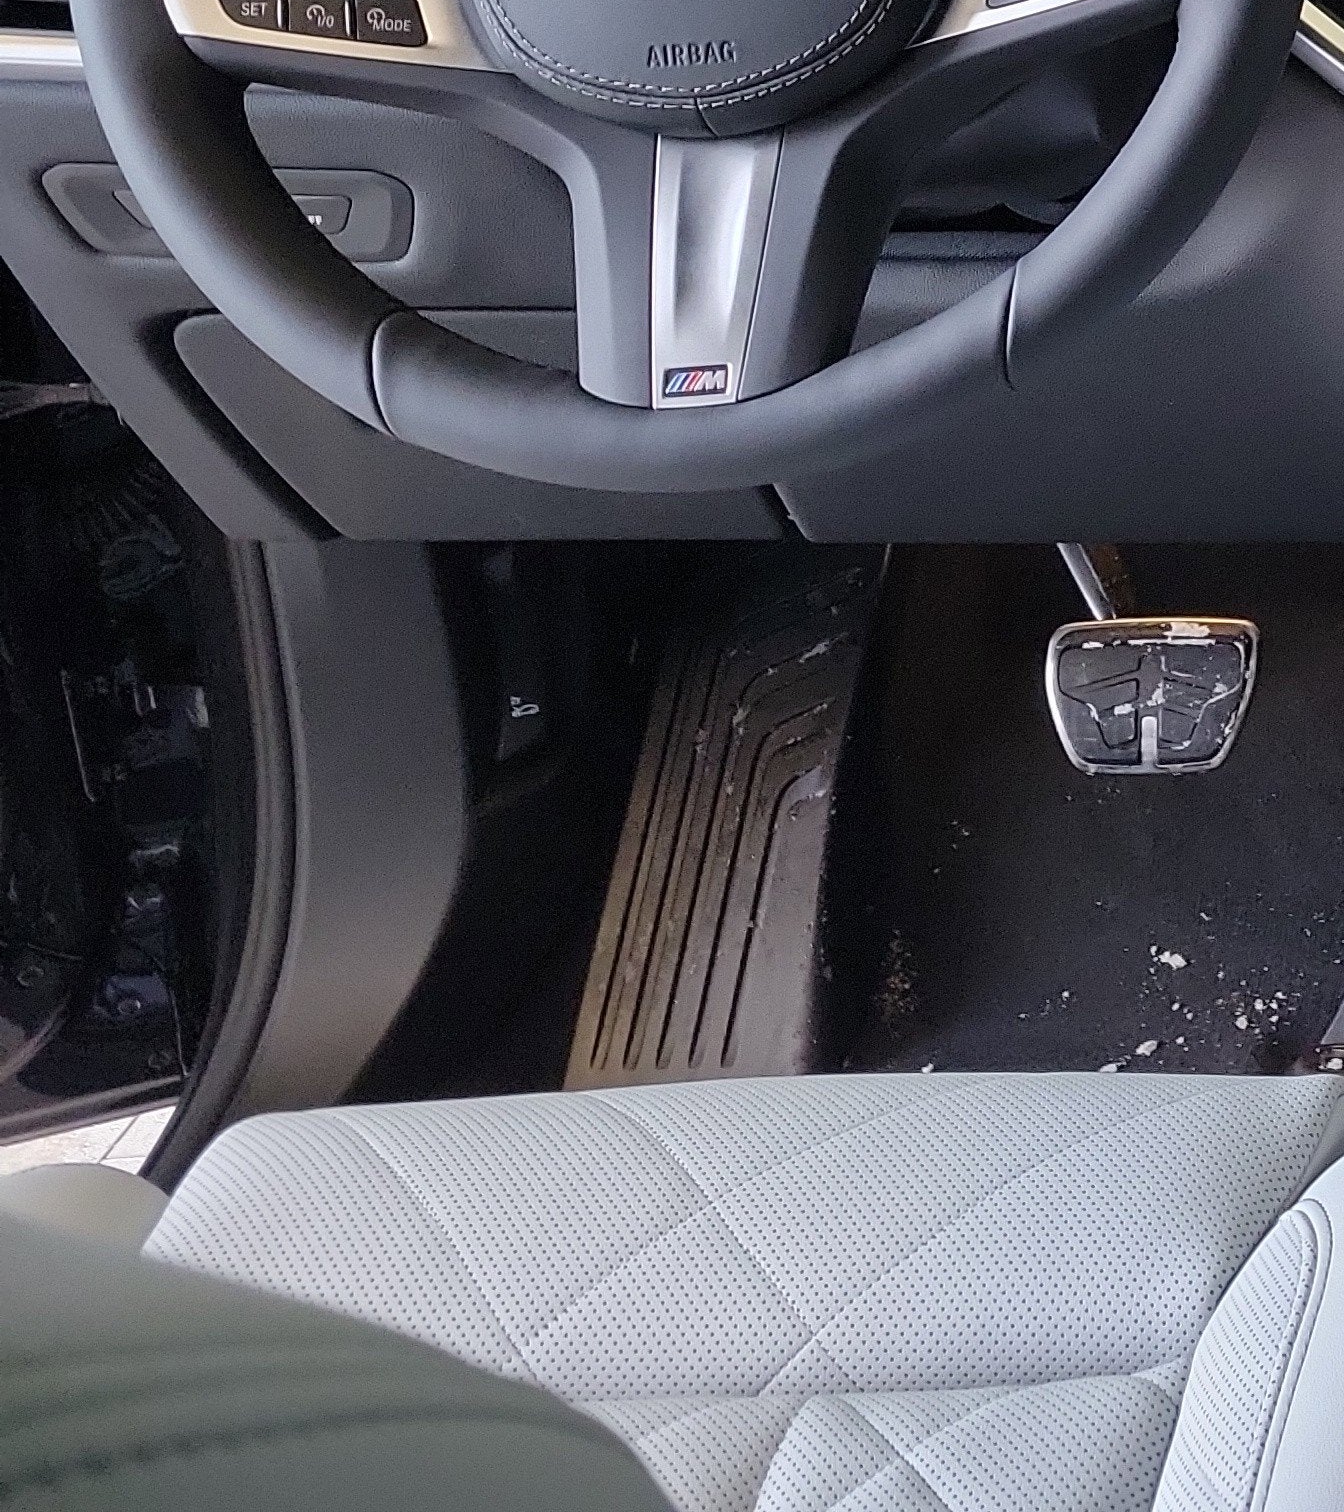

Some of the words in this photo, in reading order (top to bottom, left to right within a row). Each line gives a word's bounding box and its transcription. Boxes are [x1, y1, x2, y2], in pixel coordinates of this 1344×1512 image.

[240, 2, 267, 17] SET
[372, 17, 412, 32] MODE
[646, 41, 736, 68] AIRBAG
